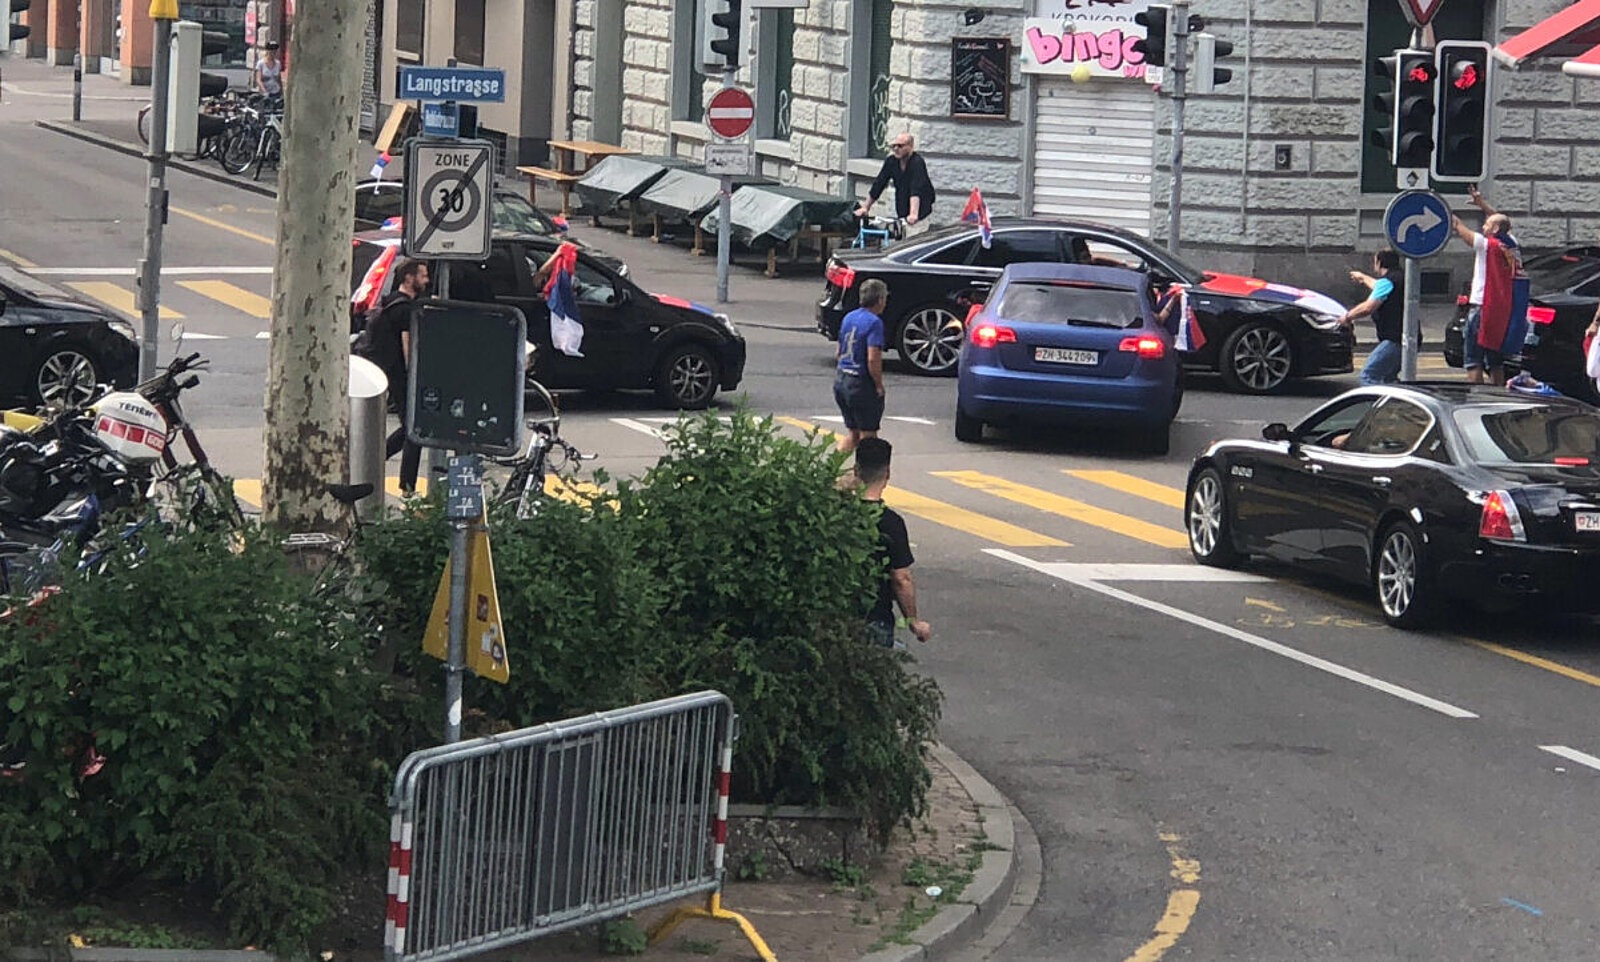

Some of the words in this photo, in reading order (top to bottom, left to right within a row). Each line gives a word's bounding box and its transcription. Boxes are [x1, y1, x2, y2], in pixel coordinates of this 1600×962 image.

[407, 74, 499, 98] Langstrasse
[435, 153, 470, 167] ZONE
[438, 188, 464, 213] 30
